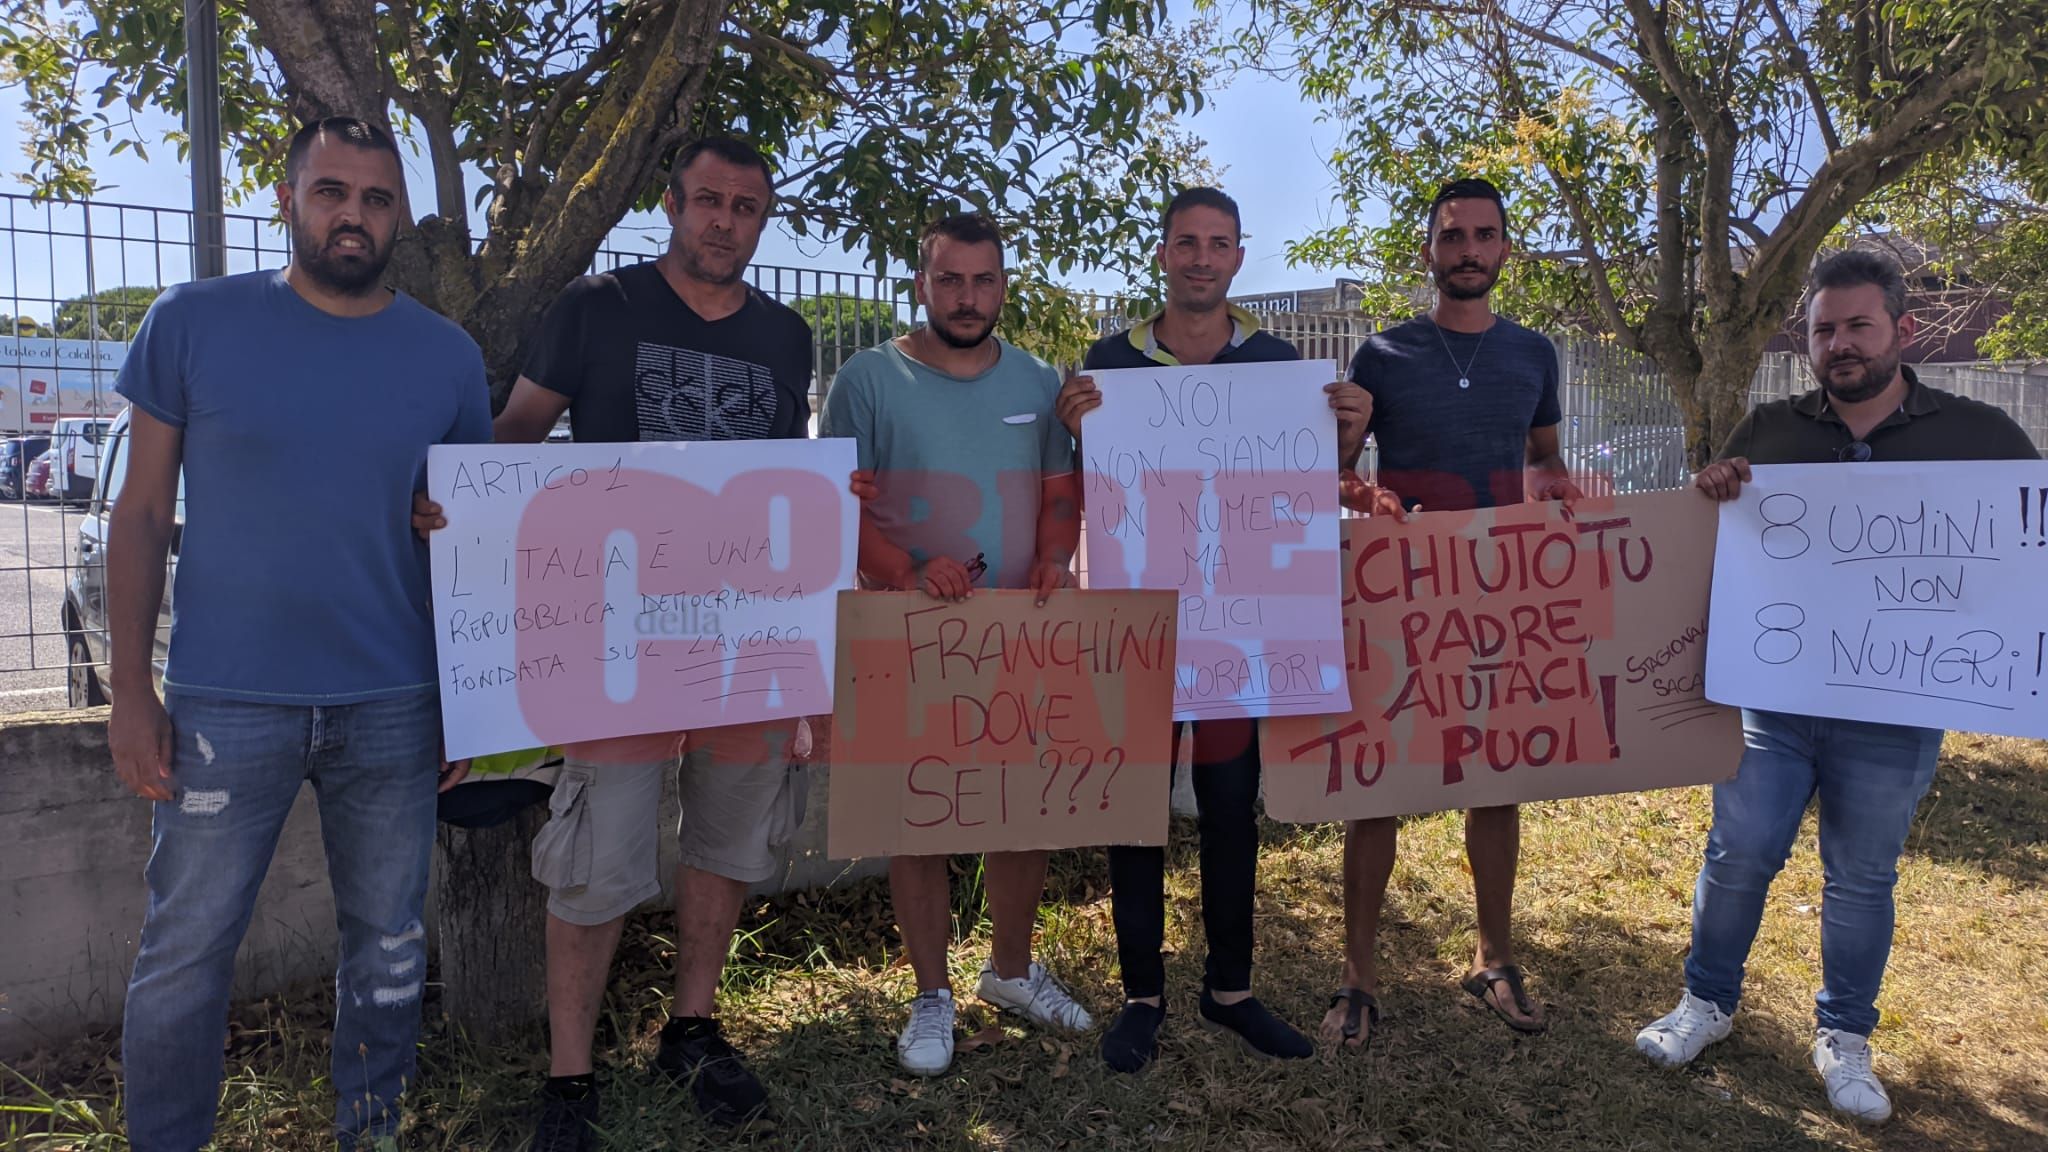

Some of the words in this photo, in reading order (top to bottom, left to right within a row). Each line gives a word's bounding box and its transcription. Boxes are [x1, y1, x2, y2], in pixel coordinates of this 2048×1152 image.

[40, 347, 51, 358] of
[605, 456, 629, 492] 1
[1090, 445, 1166, 493] NON
[1102, 501, 1145, 538] UN
[1178, 491, 1314, 535] NUMERO
[1758, 493, 1811, 560] 8
[707, 536, 773, 565] UNA
[1178, 543, 1232, 586] MA
[1575, 516, 1654, 591] TU
[1874, 565, 1964, 603] NON
[1400, 599, 1594, 668] PADRE,
[1753, 602, 1806, 665] 8
[450, 653, 566, 695] FONDATA
[594, 641, 661, 661] SUL
[687, 626, 802, 655] LAVORO
[952, 691, 1080, 747] DOVE
[1288, 720, 1386, 798] TU
